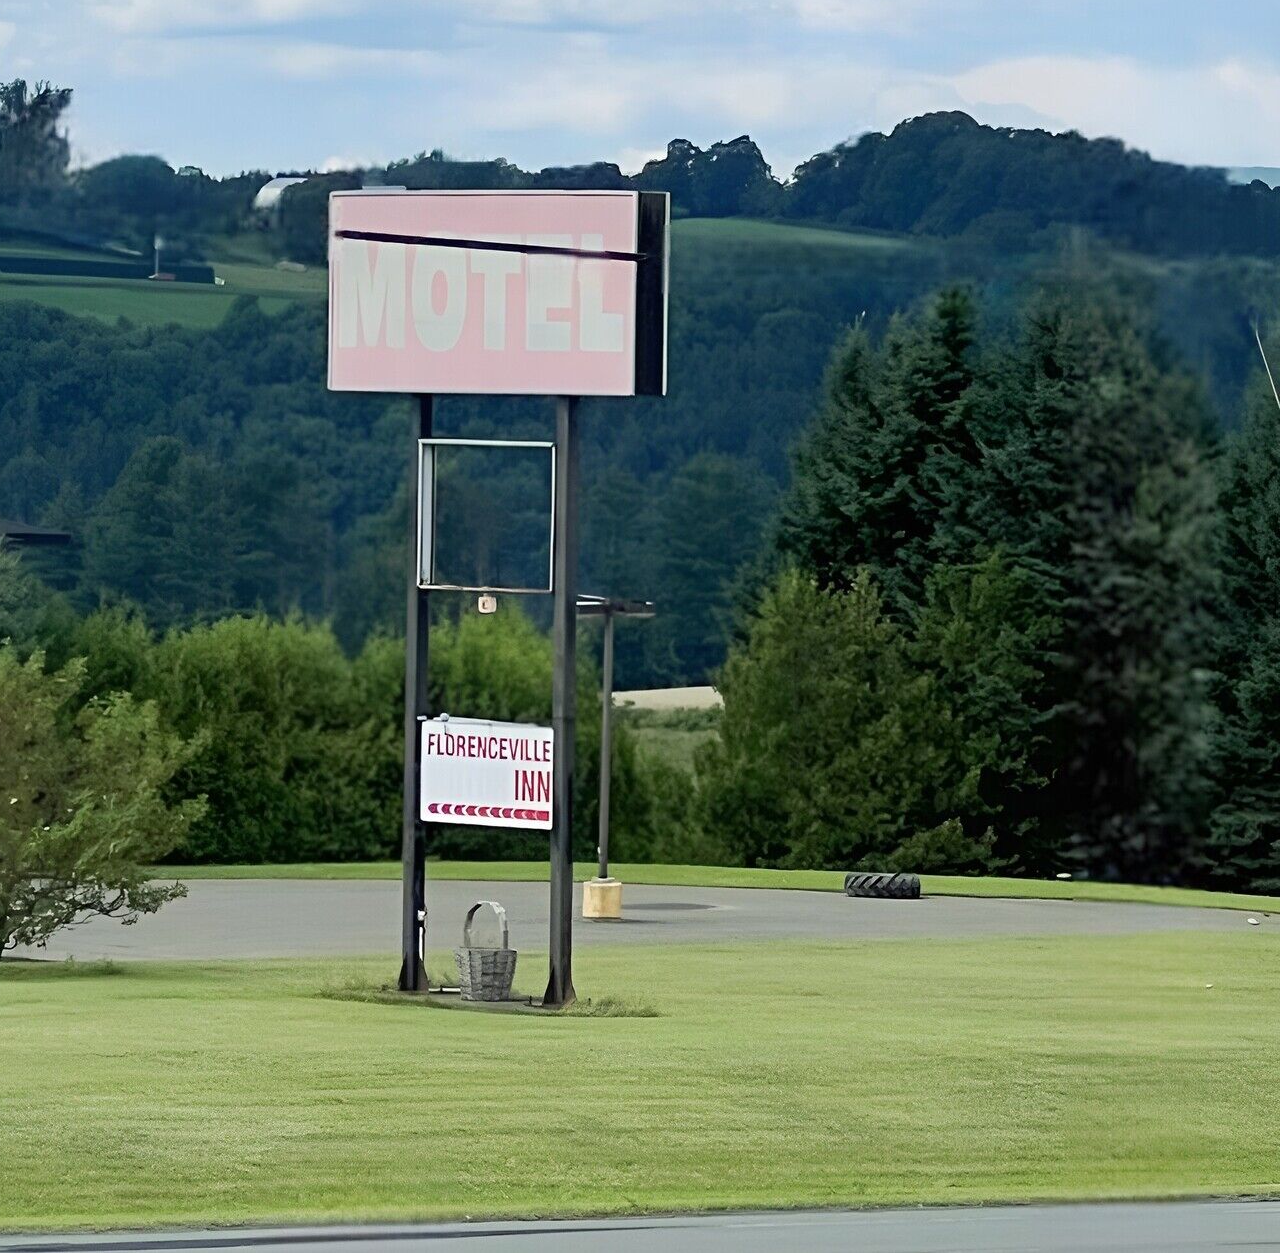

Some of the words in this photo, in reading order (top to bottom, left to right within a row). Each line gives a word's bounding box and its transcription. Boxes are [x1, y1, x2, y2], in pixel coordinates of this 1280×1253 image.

[339, 231, 625, 353] MOTEL
[427, 733, 551, 762] FLORENCEVILLE
[514, 769, 551, 803] INN
